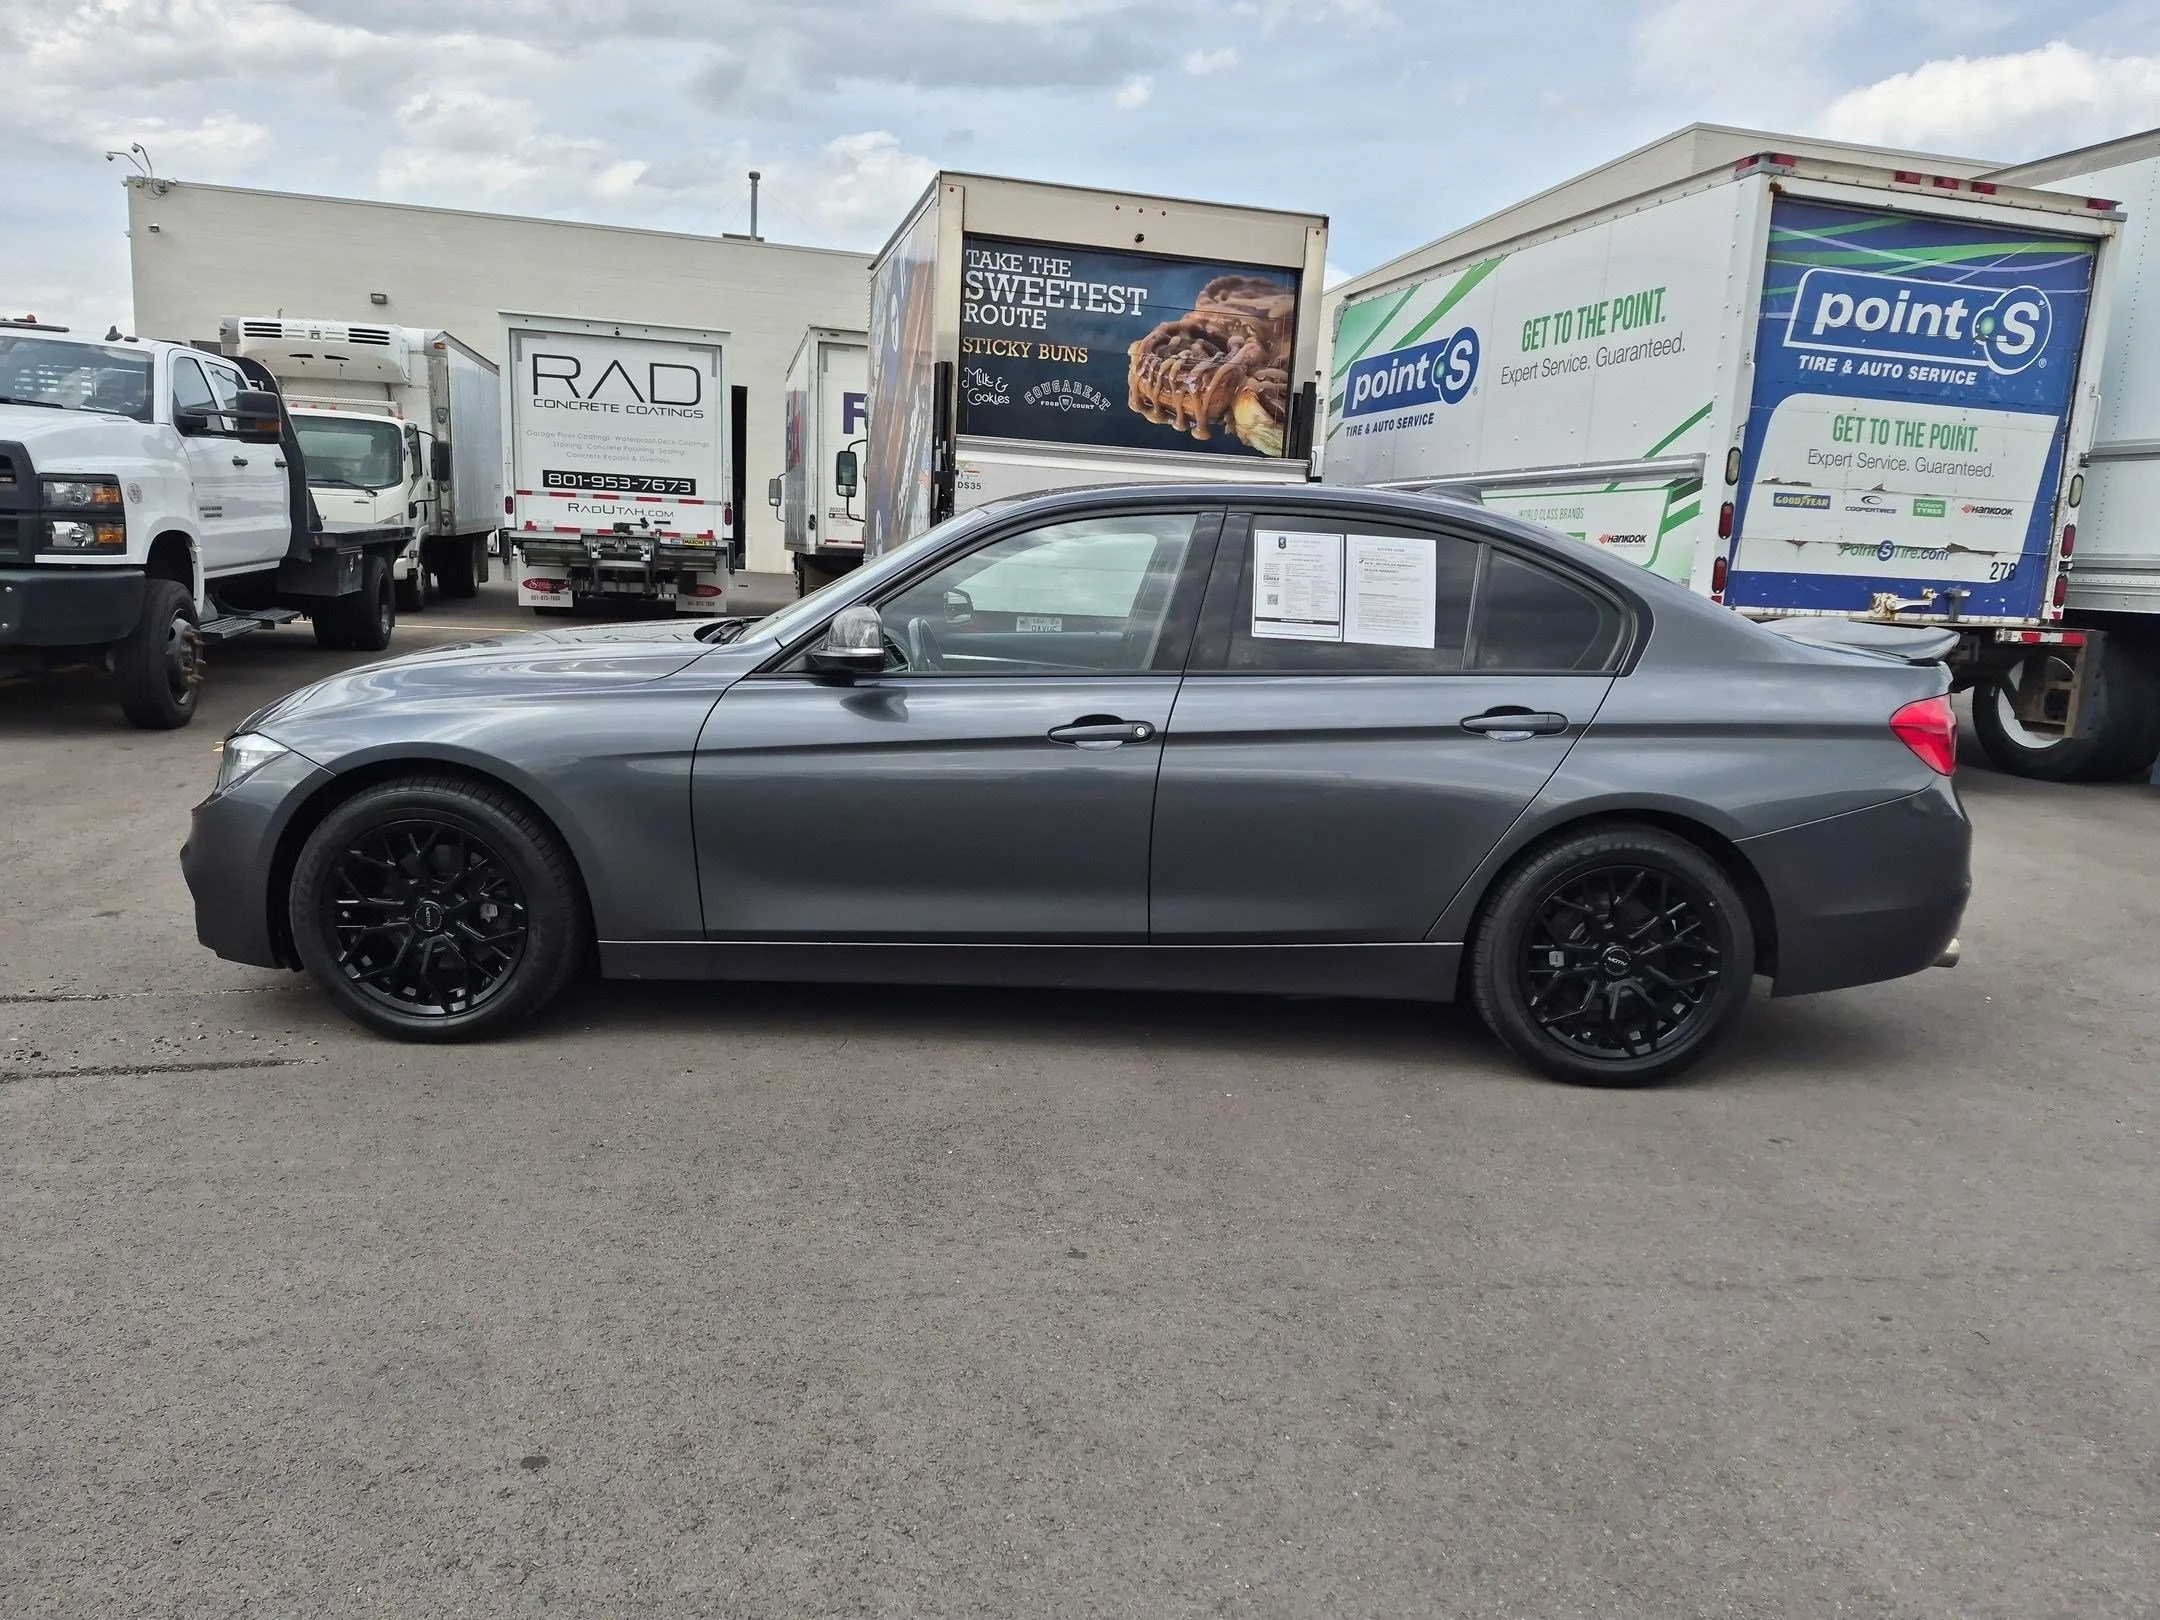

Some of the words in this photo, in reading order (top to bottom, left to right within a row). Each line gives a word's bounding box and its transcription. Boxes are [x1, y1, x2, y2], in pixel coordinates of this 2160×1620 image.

[966, 249, 1023, 273] TAKE
[1028, 256, 1072, 278] THE
[965, 270, 1148, 316] SWEETEST
[963, 302, 1047, 330] ROUTE
[1521, 316, 1550, 352] GET
[1554, 310, 1573, 346] TO
[1577, 301, 1609, 340] THE
[1611, 286, 1667, 333] POINT.
[1812, 290, 1969, 340] point
[1995, 301, 2041, 355] S
[962, 337, 1032, 358] STICKY
[1038, 343, 1089, 364] BUNS
[1501, 361, 1538, 387] Expert
[1541, 353, 1590, 378] Service.
[1595, 331, 1686, 367] Guaranteed.
[532, 353, 701, 406] RAD
[961, 367, 994, 388] Milk
[995, 377, 1009, 392] &
[1352, 351, 1430, 410] point
[1445, 339, 1473, 391] S
[1798, 355, 1837, 372] TIRE
[1841, 359, 1853, 372] &
[1857, 360, 1903, 378] AUTO
[1908, 365, 1977, 386] SERVICE
[967, 388, 1010, 406] Cookies
[1023, 379, 1112, 411] COUGAREAT
[533, 398, 620, 413] CONCRETE
[626, 404, 704, 419] COATINGS
[1346, 425, 1363, 438] TIRE
[1364, 424, 1370, 434] &
[1372, 420, 1395, 433] AUTO
[1396, 412, 1435, 430] SERVICE
[1832, 415, 1866, 443] GET
[1870, 418, 1890, 445] TO
[1895, 420, 1926, 448] THE
[1929, 423, 1978, 452] POINT.
[526, 430, 556, 438] Garage
[557, 431, 575, 439] Floor
[577, 433, 610, 441] Coatings
[615, 435, 656, 445] Waterproof
[678, 439, 710, 448] Coatings
[553, 441, 582, 450] Staining
[587, 443, 622, 451] Concrete
[623, 444, 655, 454] Polishing
[659, 447, 686, 456] Sealing
[566, 451, 601, 460] Concrete
[603, 453, 630, 462] Repairs
[1807, 448, 1852, 469] Expert
[1857, 452, 1910, 472] Service.
[1915, 456, 1994, 478] Guaranteed.
[548, 473, 691, 493] 801-953-7673
[957, 481, 982, 490] DS35
[1540, 508, 1559, 521] CLASS
[1559, 507, 1585, 520] BRANDS
[1775, 495, 1829, 507] GOODYEAR
[1916, 507, 1942, 515] TYRES
[1989, 562, 2017, 581] 278
